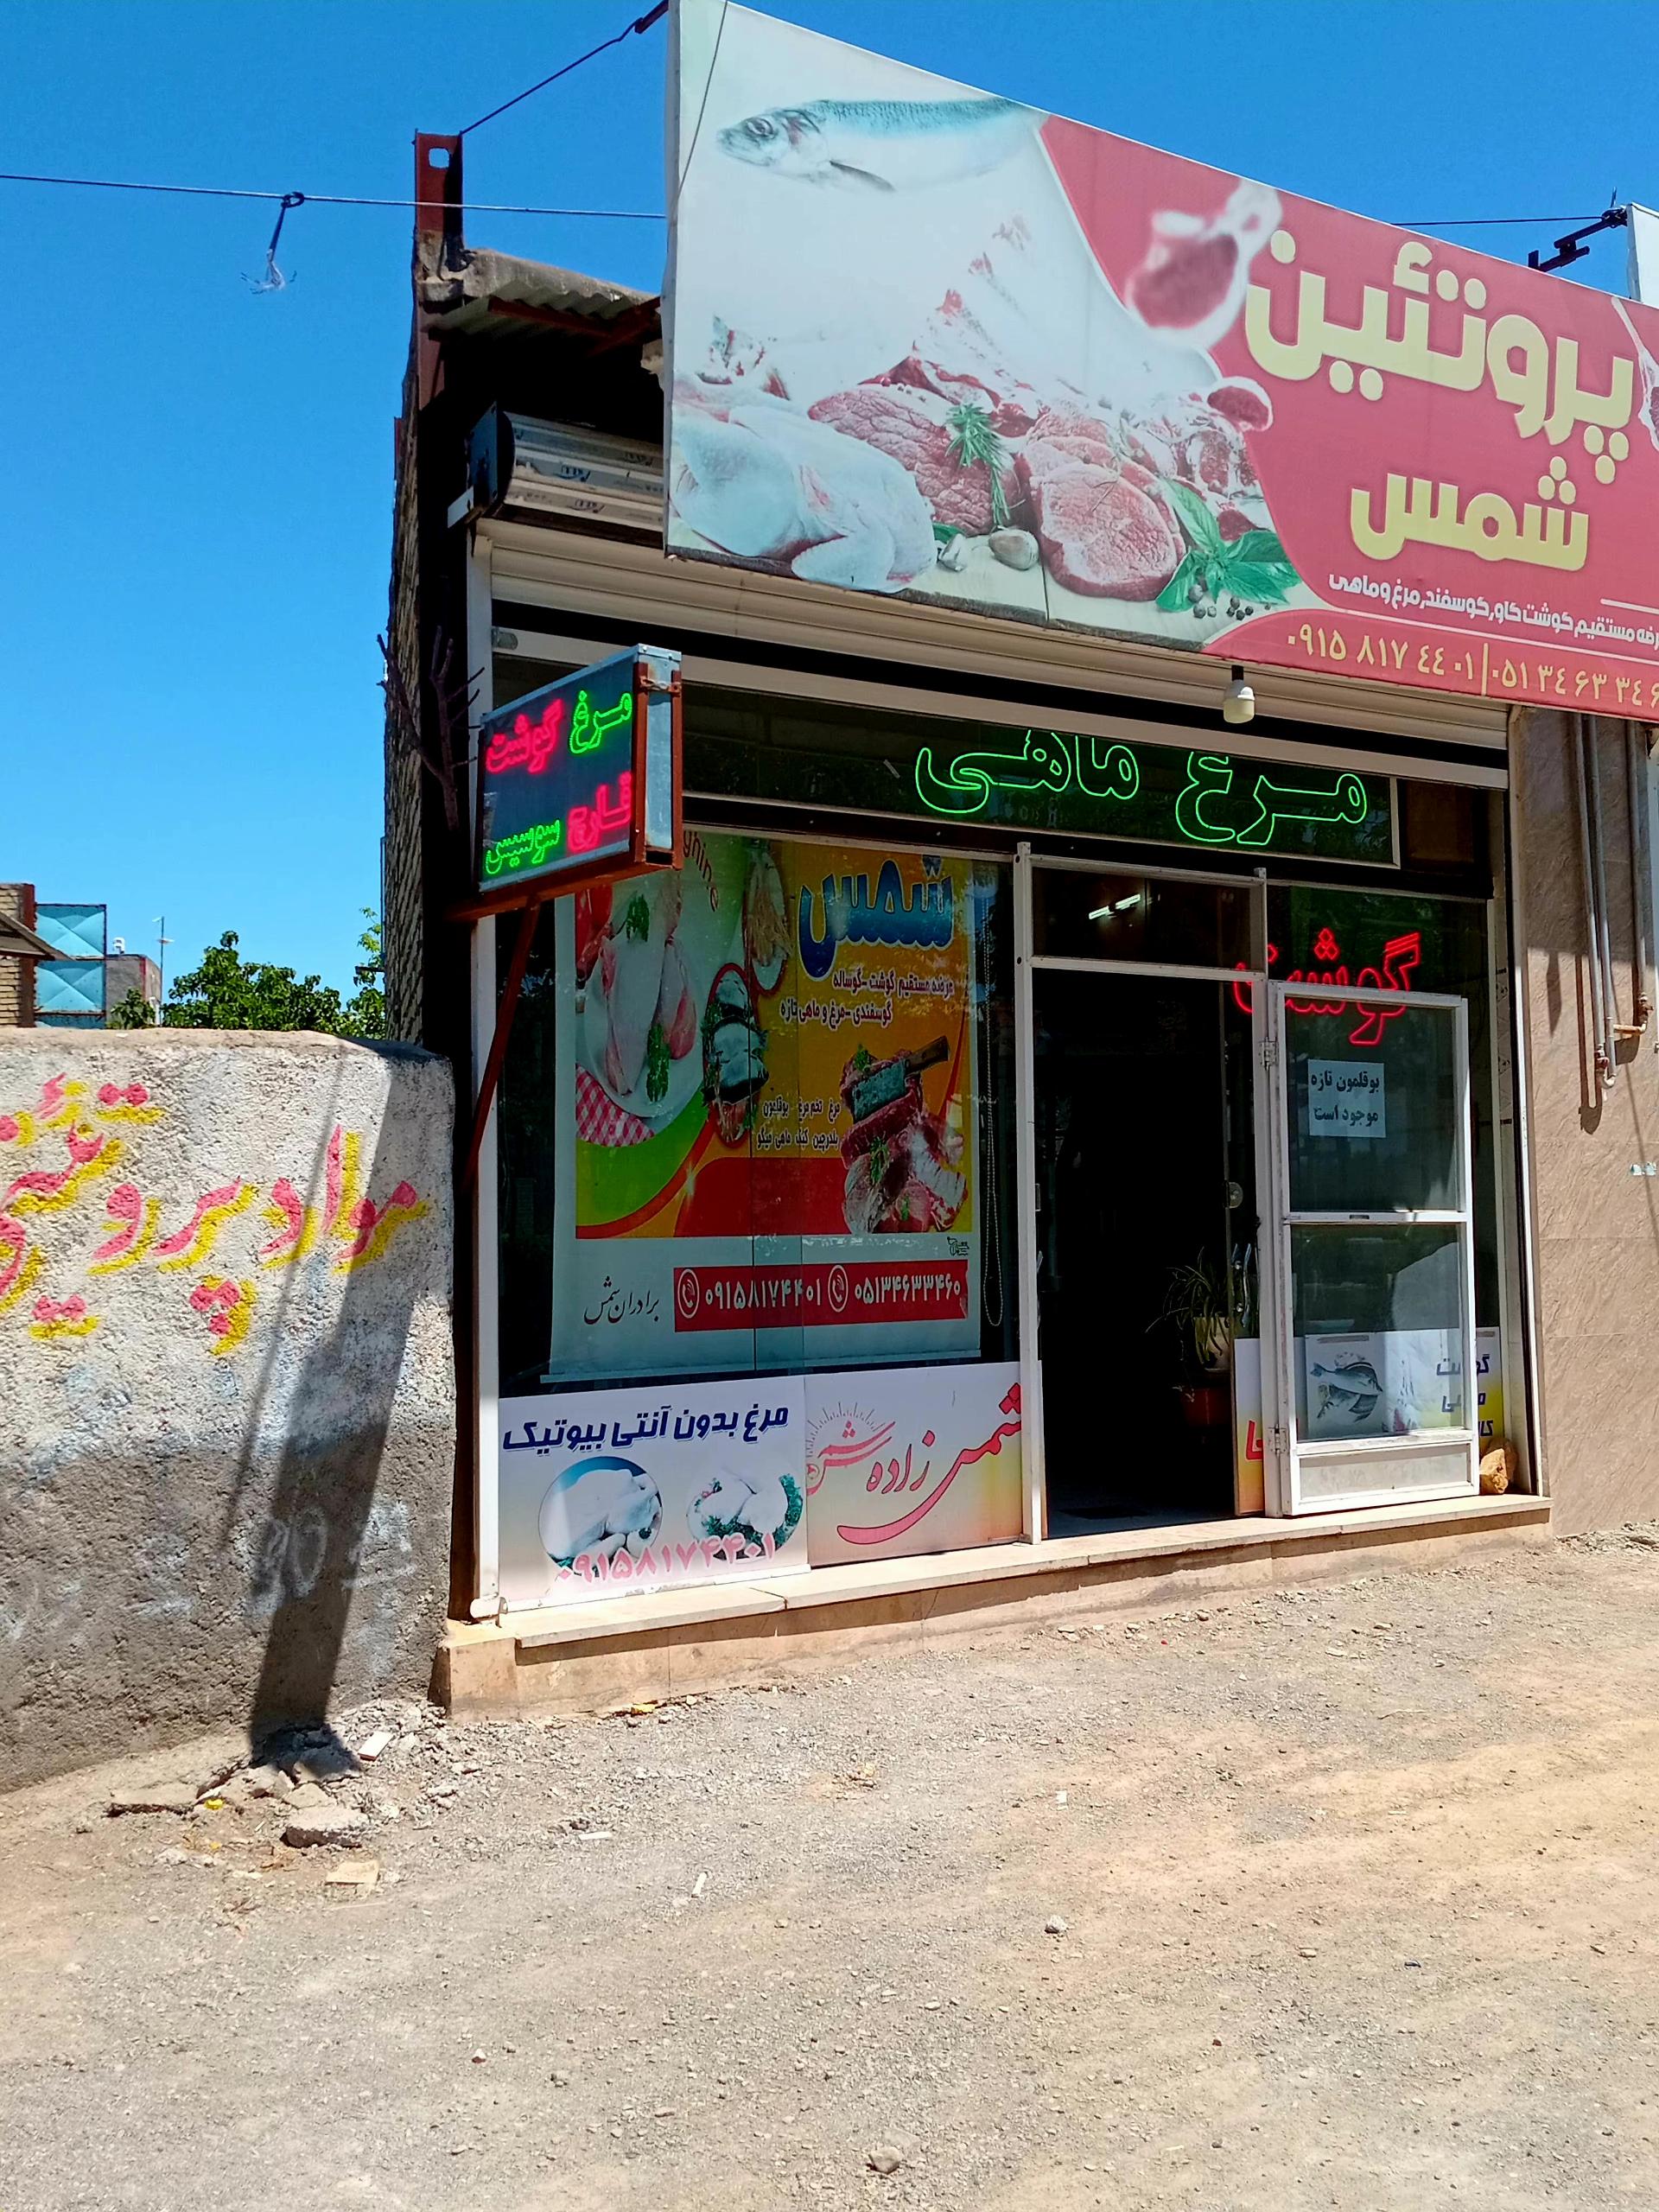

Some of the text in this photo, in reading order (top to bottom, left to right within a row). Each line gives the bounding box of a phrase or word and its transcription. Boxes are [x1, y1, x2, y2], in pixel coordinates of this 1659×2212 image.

[1244, 229, 1634, 485] پروتئین
[1350, 455, 1589, 571] شمس
[486, 690, 632, 773] گوشت مرغ
[798, 854, 954, 982] شمس
[869, 969, 895, 995] گوشت
[1311, 1070, 1332, 1091] تازه
[1313, 1104, 1339, 1121] است
[584, 1275, 660, 1325] برادران شمس
[502, 1403, 789, 1455] مرغ بدون آنتی بیوتیک
